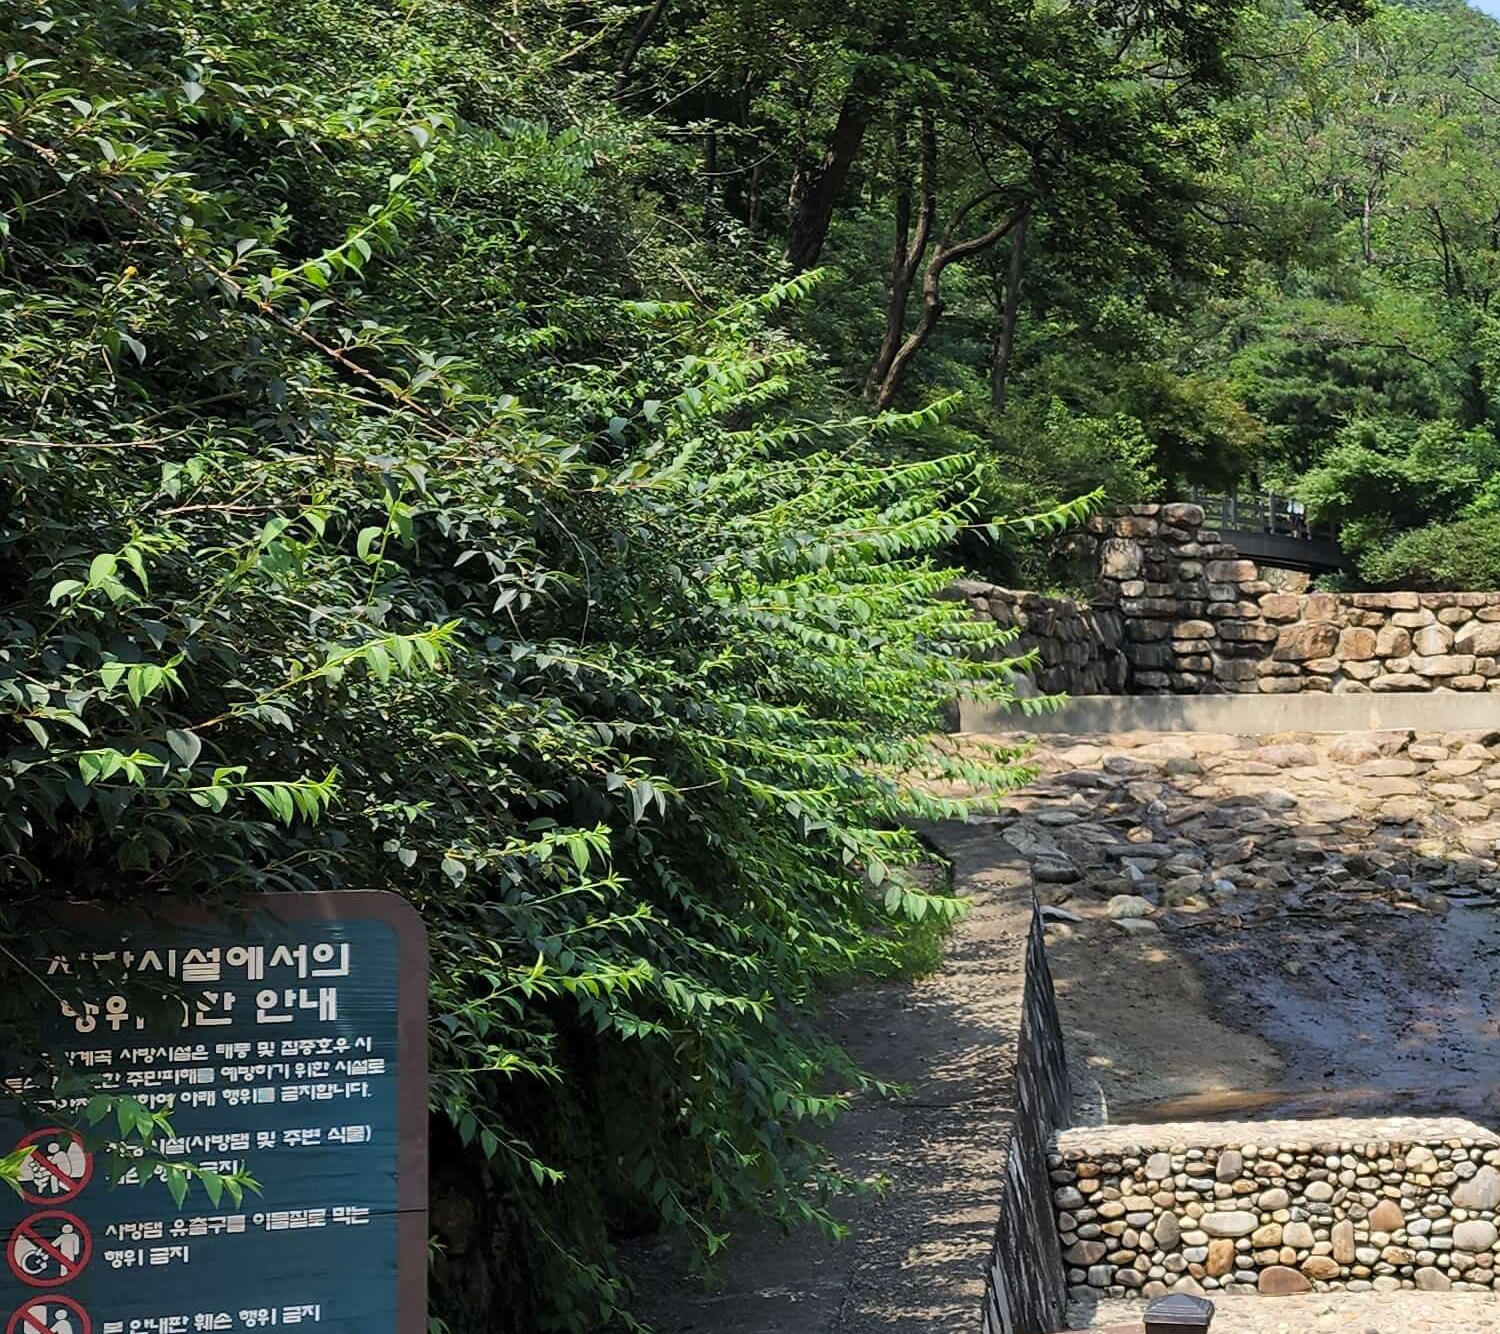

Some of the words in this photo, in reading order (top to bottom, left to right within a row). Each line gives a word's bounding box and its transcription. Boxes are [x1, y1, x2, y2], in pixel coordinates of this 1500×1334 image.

[46, 942, 350, 983] 사시설에서의
[60, 990, 236, 1033] 행위한
[255, 987, 338, 1024] 안내
[119, 1043, 209, 1064] 사방시설은
[215, 1041, 251, 1060] 태풍
[256, 1040, 276, 1058] 및
[280, 1036, 351, 1056] 집중호우
[354, 1036, 372, 1052] 시
[126, 1067, 215, 1087] 주민피해를
[220, 1063, 290, 1082] 예방하기
[294, 1060, 330, 1078] 위한
[334, 1058, 386, 1076] 시설로
[180, 1090, 216, 1107] 아래
[222, 1087, 276, 1106] 행위를
[280, 1081, 373, 1101] 금지합니다.
[256, 1130, 277, 1149] 및
[284, 1129, 321, 1147] 주변
[327, 1124, 372, 1144] 식물)
[105, 1221, 163, 1241] 사방댐
[169, 1214, 246, 1237] 유출구를
[252, 1208, 327, 1231] 이물질로
[331, 1205, 371, 1225] 막는
[104, 1248, 143, 1268] 행위
[149, 1245, 189, 1265] 금지
[193, 1312, 233, 1331] 훼손
[238, 1308, 277, 1328] 행위
[282, 1304, 321, 1324] 금지
